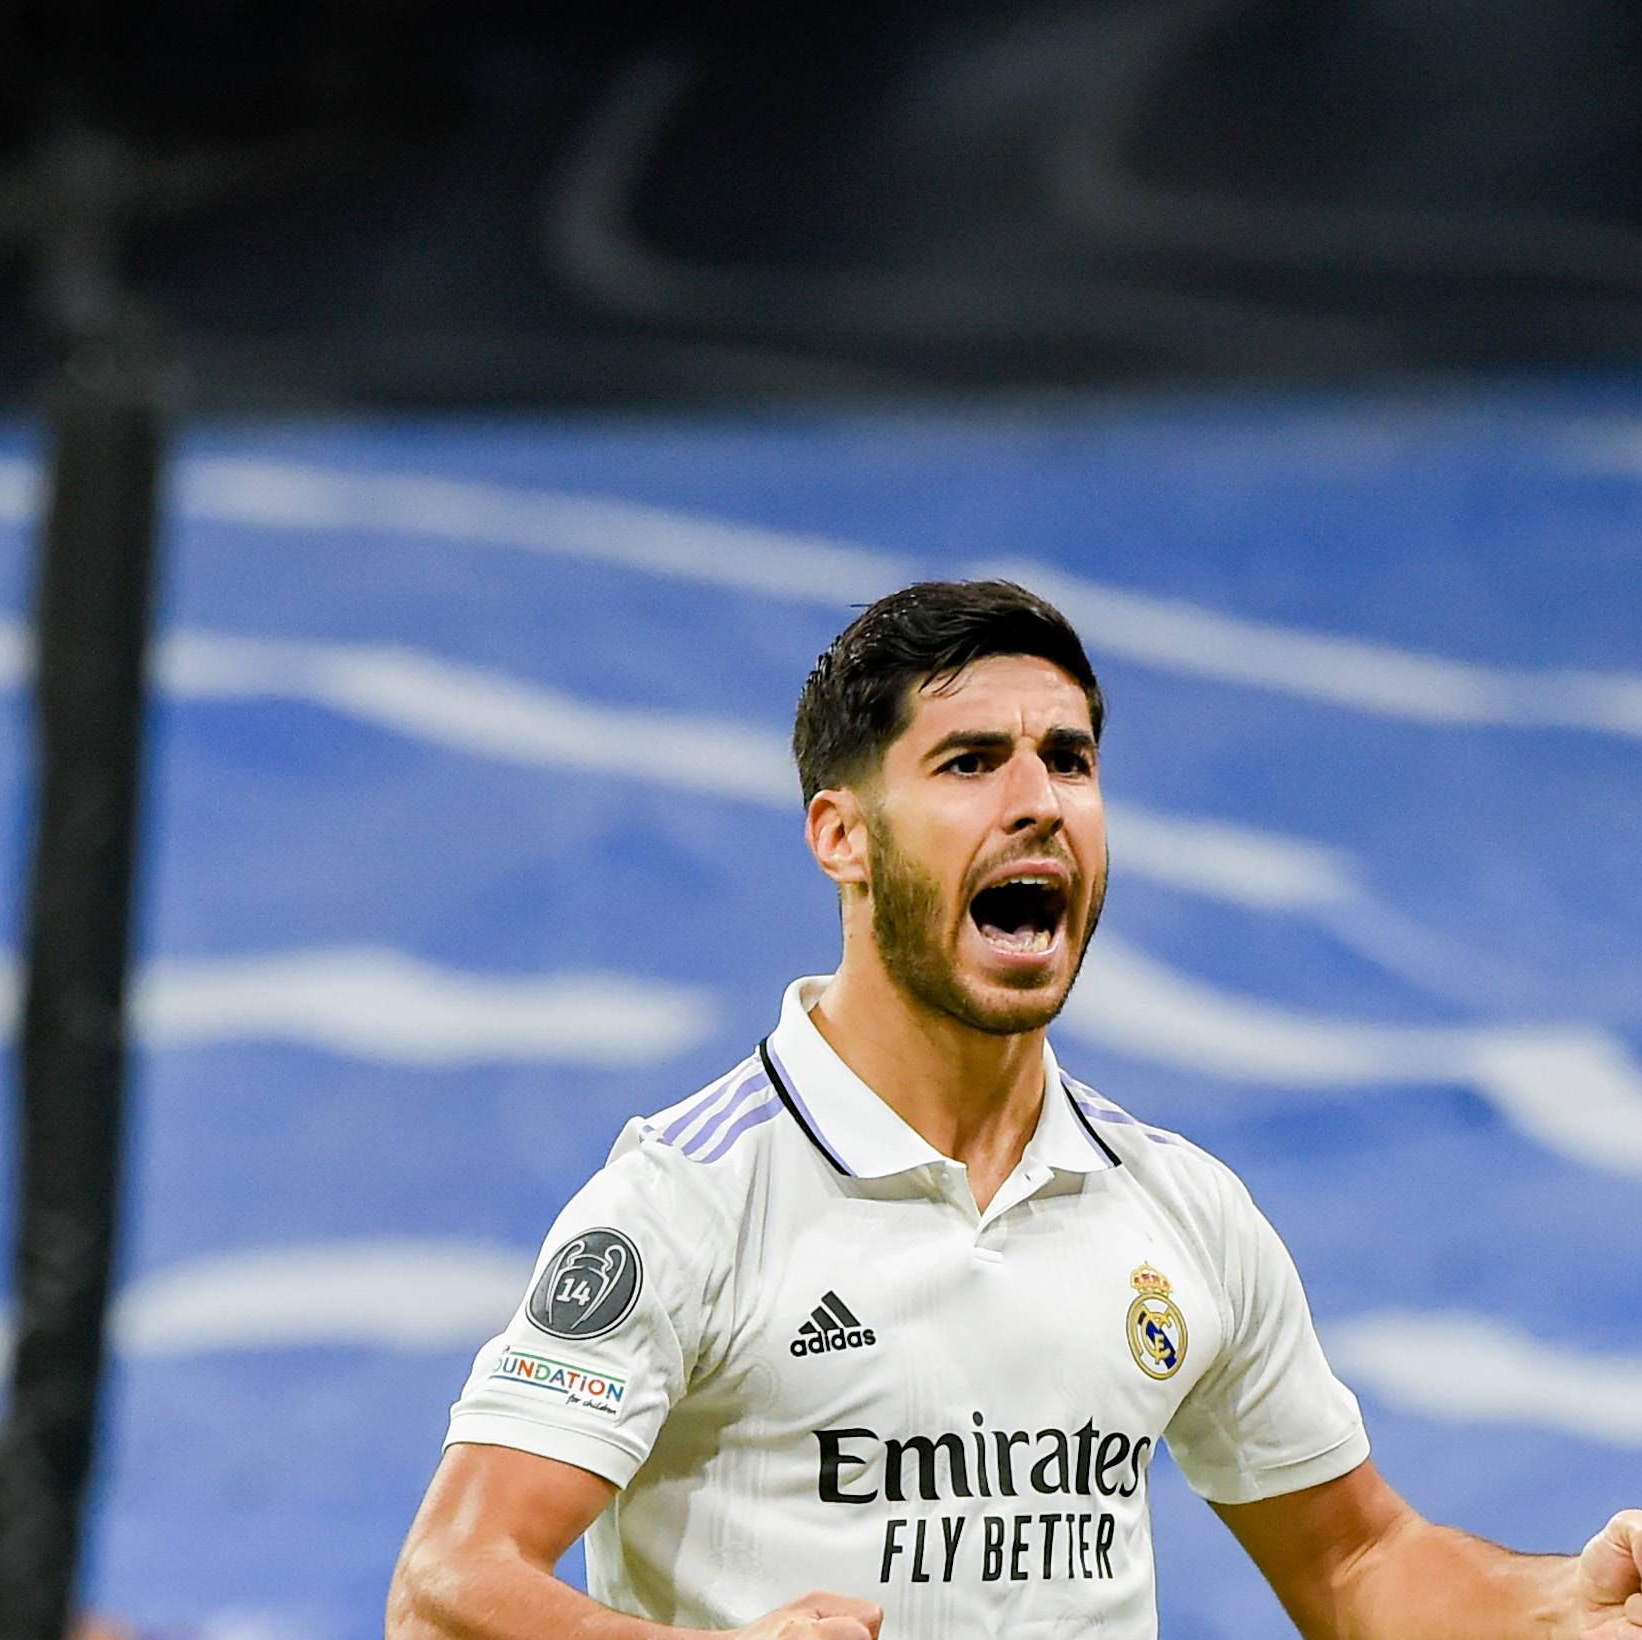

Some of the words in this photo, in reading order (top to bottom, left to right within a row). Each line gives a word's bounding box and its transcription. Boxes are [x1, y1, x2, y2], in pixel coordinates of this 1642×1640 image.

[556, 1277, 591, 1306] 14
[790, 1328, 876, 1357] adidas
[812, 1411, 1152, 1504] Emirates
[880, 1516, 966, 1583] FLY
[981, 1513, 1116, 1582] BETTER
